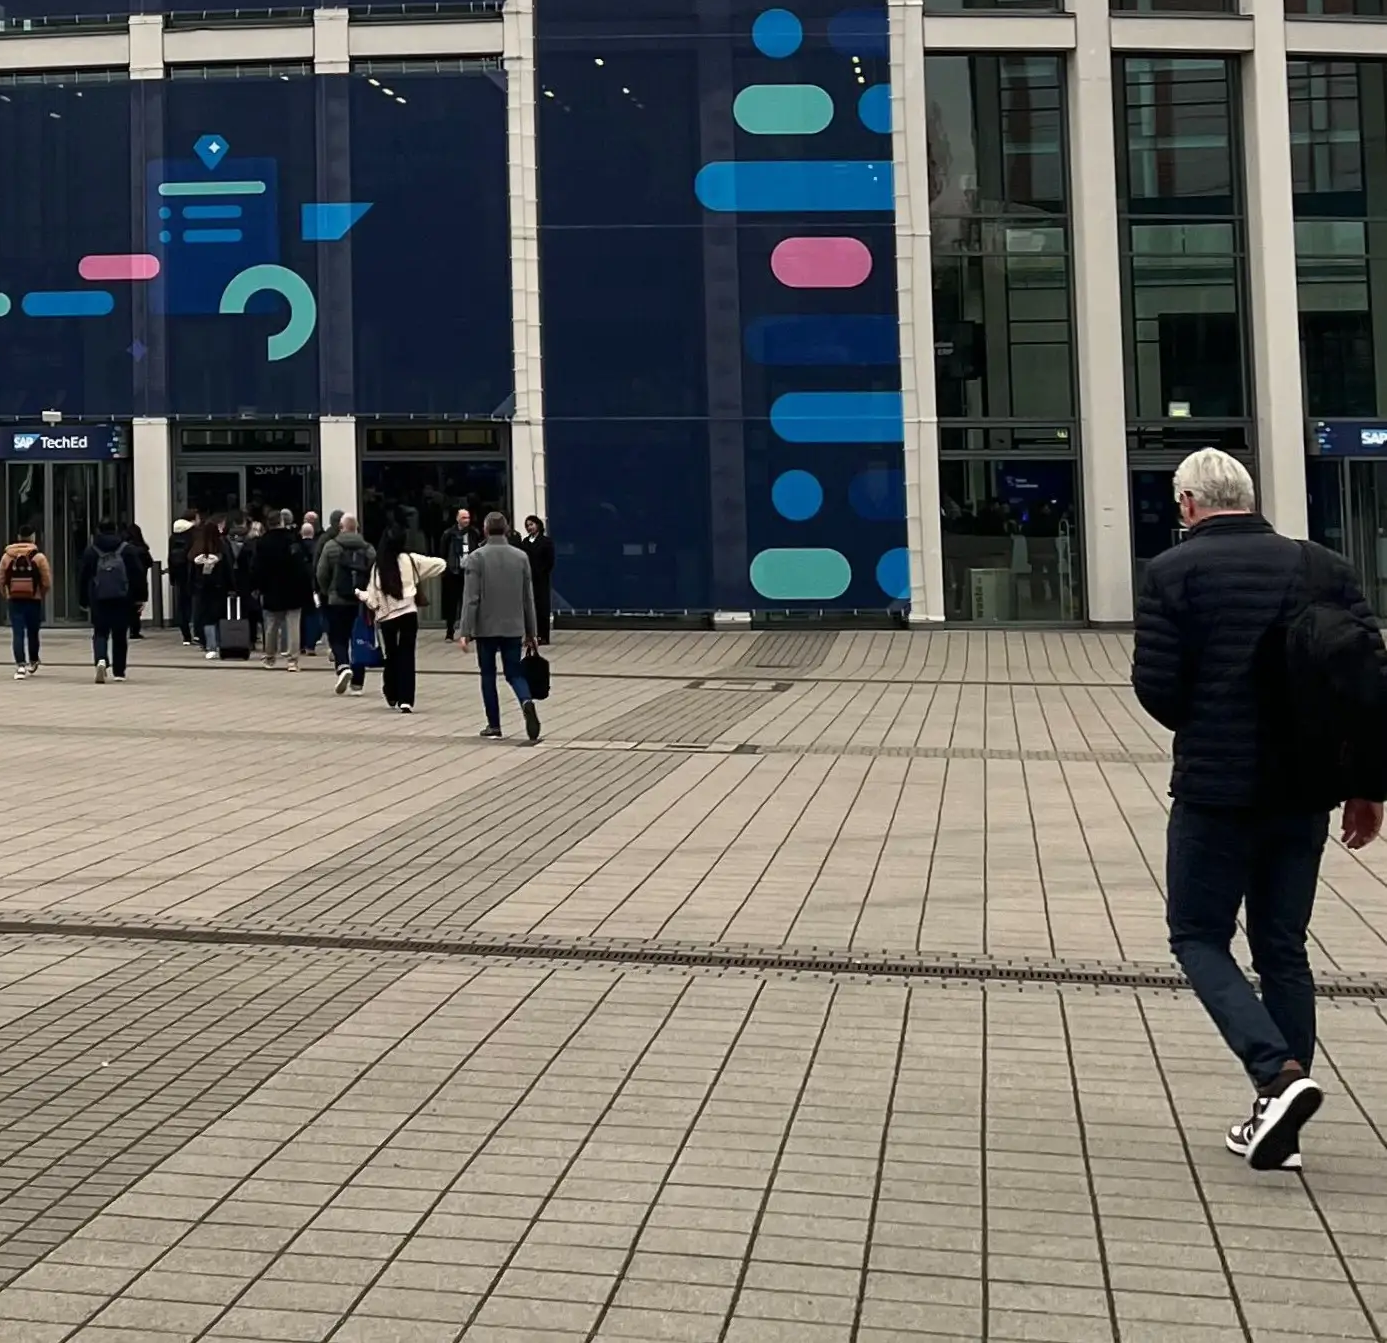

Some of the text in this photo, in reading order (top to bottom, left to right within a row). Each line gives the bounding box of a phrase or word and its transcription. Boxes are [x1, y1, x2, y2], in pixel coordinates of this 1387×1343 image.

[14, 436, 88, 449] SAP TechEd
[1361, 431, 1387, 445] SAP
